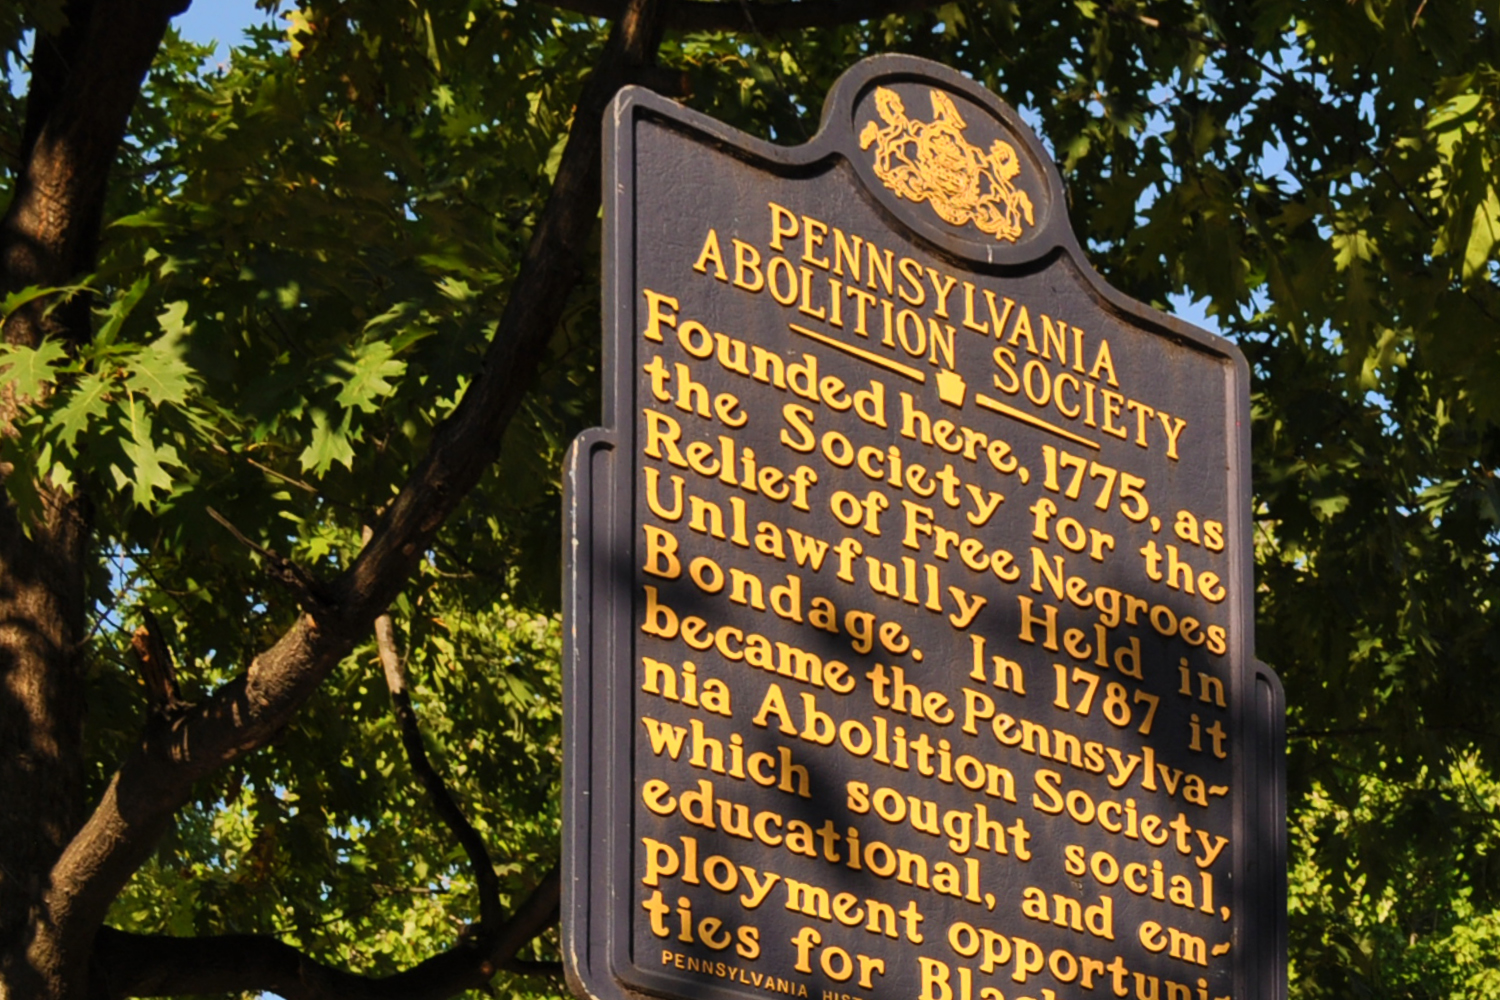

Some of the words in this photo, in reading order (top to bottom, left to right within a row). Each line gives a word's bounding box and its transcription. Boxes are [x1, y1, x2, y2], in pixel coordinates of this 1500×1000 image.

[693, 228, 957, 370] ABOLITION
[993, 347, 1187, 460] SOCIETY
[767, 201, 1119, 387] PENNSYLVANIA
[643, 289, 886, 428] Founded
[900, 392, 1029, 485] here,
[1042, 444, 1162, 533] 1775,
[1173, 510, 1225, 552] as
[643, 355, 748, 427] the
[780, 400, 1004, 527] Society
[1029, 497, 1115, 561] for
[1139, 540, 1226, 603] the
[643, 409, 818, 511] Relief
[830, 489, 889, 536] of
[901, 499, 1021, 582] Free
[1029, 546, 1227, 655] Negroes
[643, 466, 987, 629] Unlawfully
[1017, 595, 1144, 681] Held
[1178, 657, 1227, 709] in
[641, 586, 856, 693] became
[866, 661, 955, 725] the
[642, 525, 925, 661] Bondage.
[969, 634, 1026, 695] In
[1053, 663, 1159, 735] 1787
[1189, 713, 1227, 759] it
[641, 655, 733, 716] nia
[752, 682, 1018, 803] Abolition
[1032, 767, 1229, 868] Society
[641, 715, 812, 798] which
[846, 778, 1032, 861] sought
[1064, 843, 1232, 922] social,
[641, 779, 996, 911] educational,
[1021, 886, 1115, 941] and
[641, 837, 925, 944] ployment
[641, 890, 761, 960] ties
[790, 926, 887, 990] for
[661, 949, 809, 998] PENNSYLVANIA
